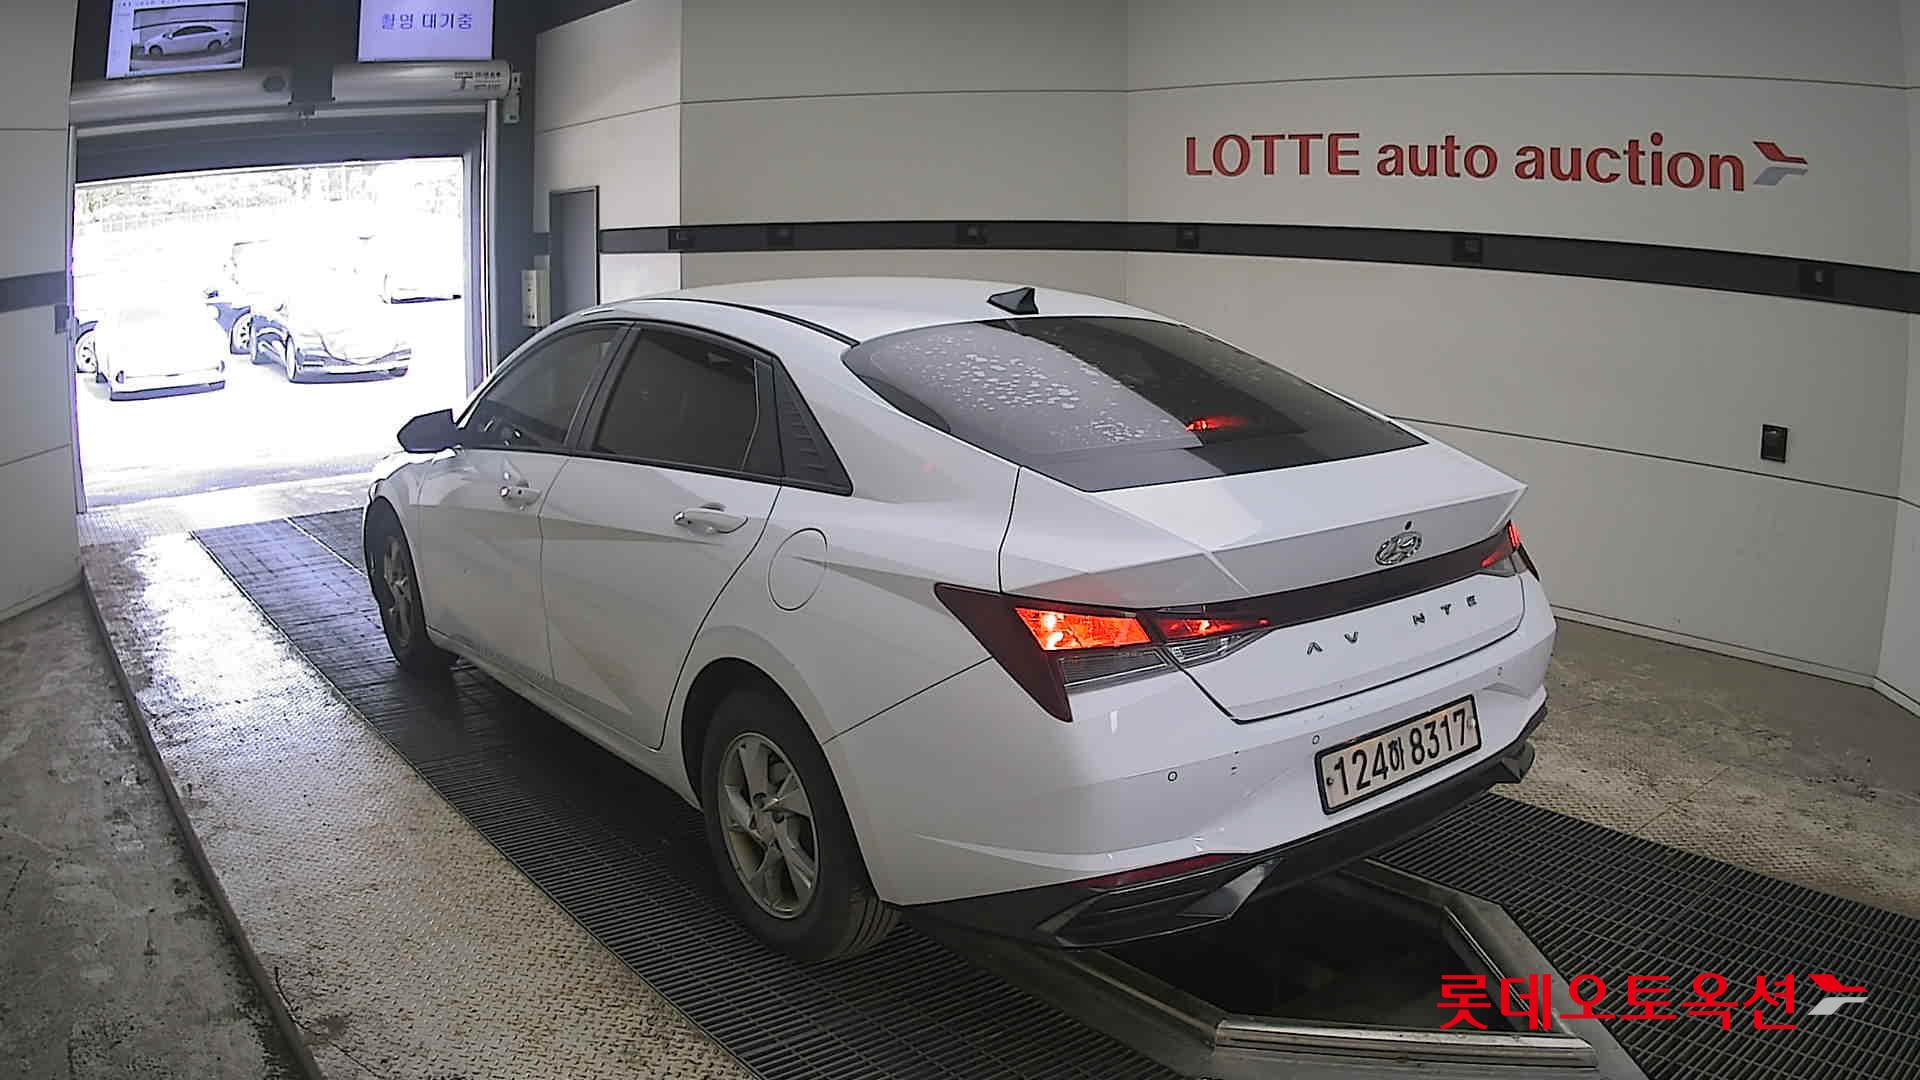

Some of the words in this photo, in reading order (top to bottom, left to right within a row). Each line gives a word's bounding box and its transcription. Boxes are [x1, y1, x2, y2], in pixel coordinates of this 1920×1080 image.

[422, 13, 473, 30] 대기중
[1186, 133, 1360, 177] LOTTE
[1376, 137, 1499, 178] auto
[1515, 133, 1745, 192] auction
